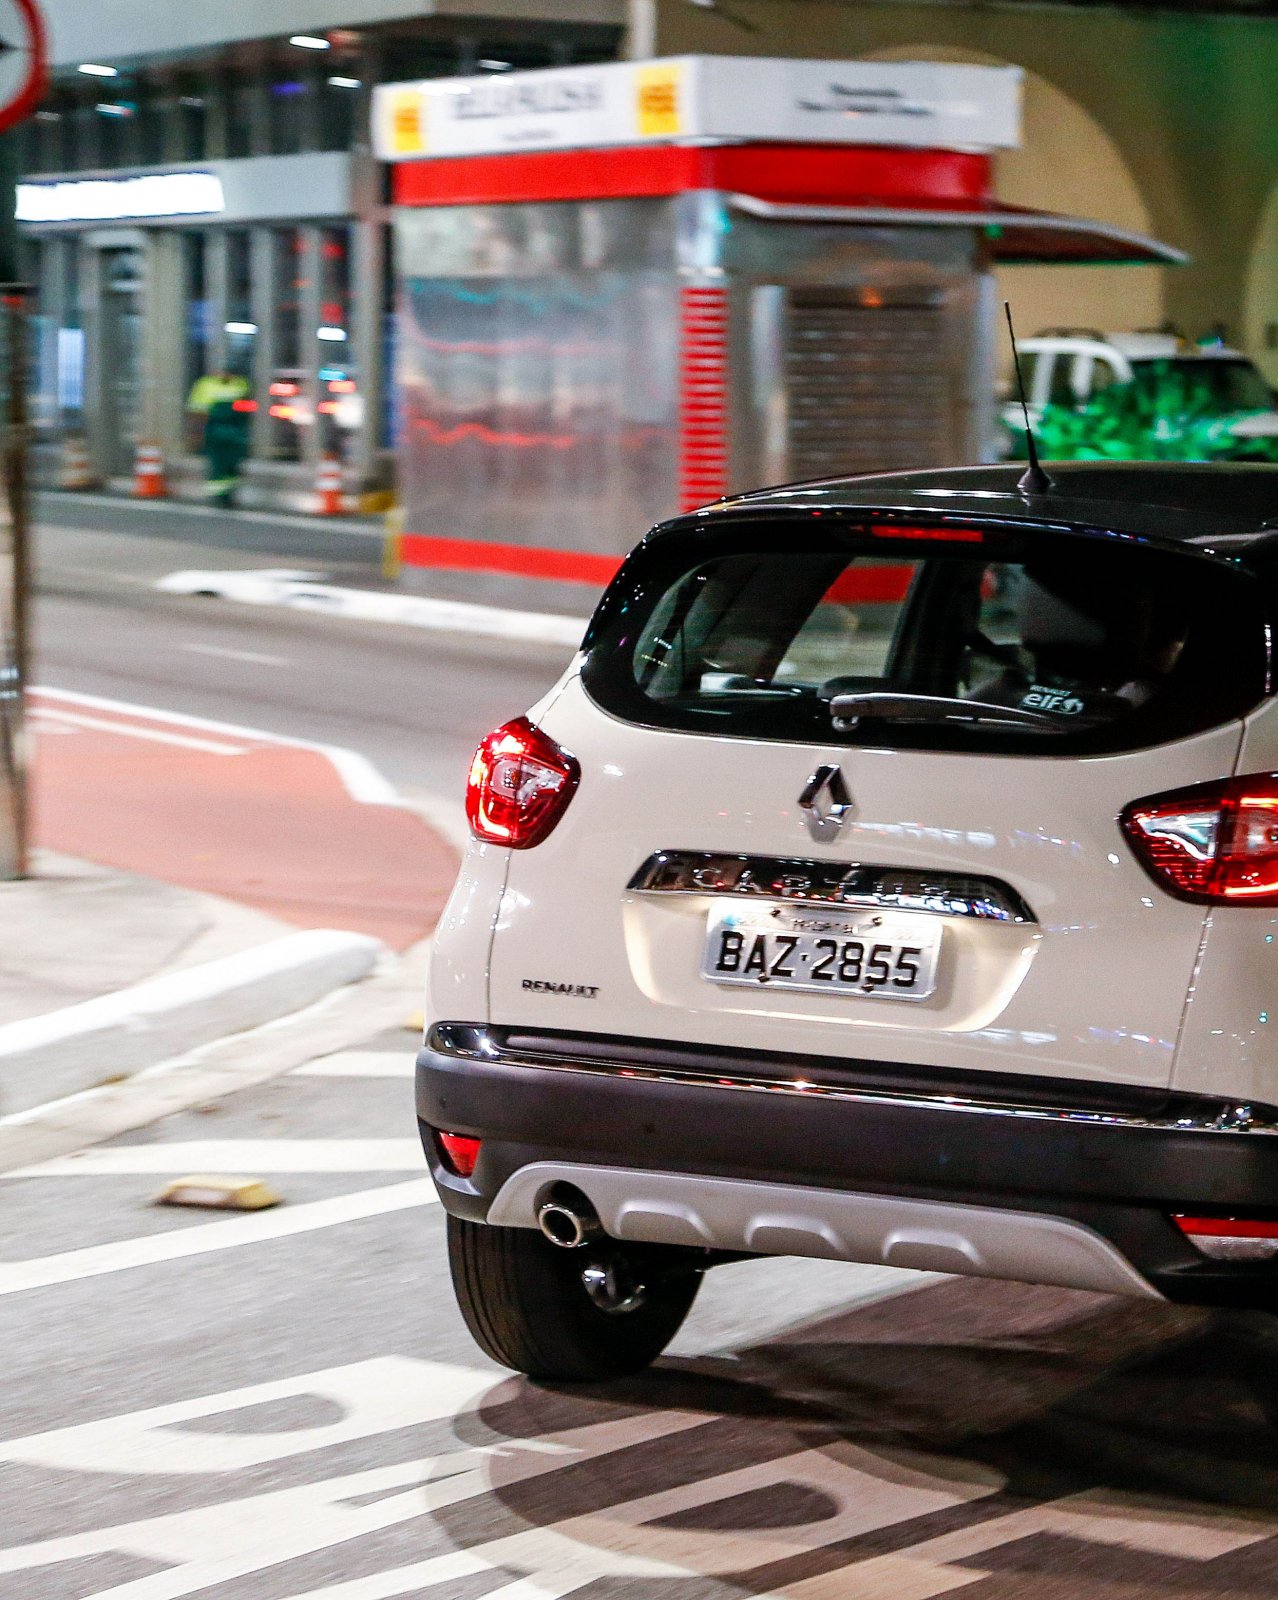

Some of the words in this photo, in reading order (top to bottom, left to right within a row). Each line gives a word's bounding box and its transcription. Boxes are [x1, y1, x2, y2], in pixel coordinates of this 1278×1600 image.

[716, 930, 801, 978] BAZ
[810, 938, 922, 987] 2855
[522, 979, 600, 999] RENAULT
